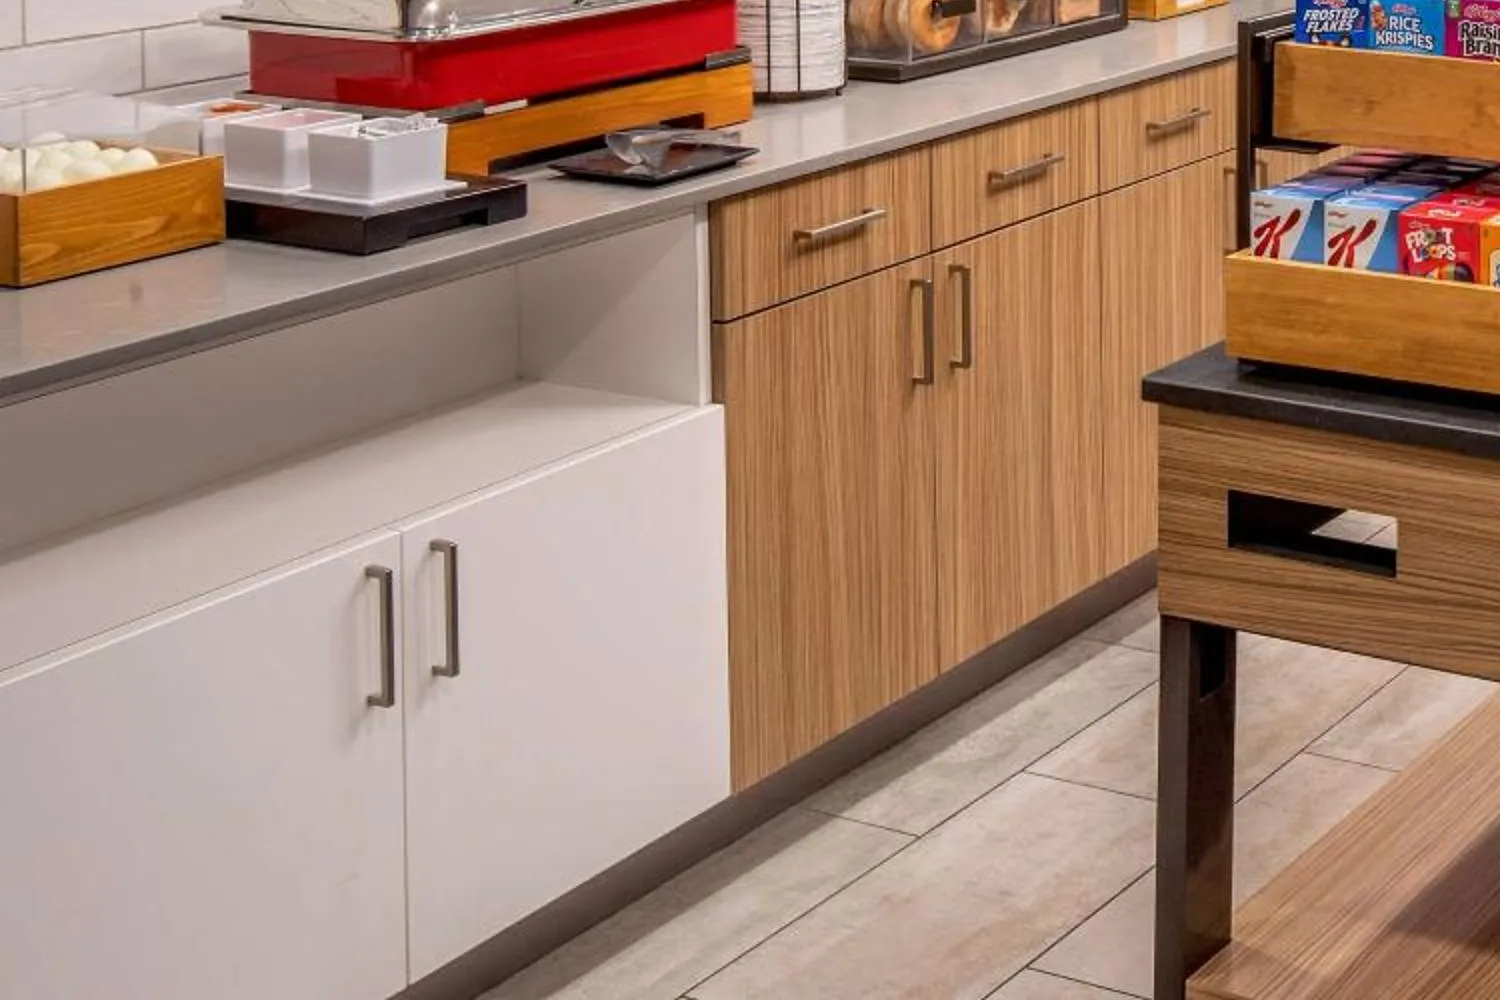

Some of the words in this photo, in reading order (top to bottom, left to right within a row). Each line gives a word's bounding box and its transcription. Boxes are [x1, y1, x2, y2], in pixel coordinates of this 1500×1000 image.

[1303, 7, 1360, 22] FROSTED
[1306, 19, 1354, 34] FLAKES
[1389, 15, 1422, 33] RICE
[1375, 31, 1434, 50] KRISPIES
[1254, 208, 1301, 260] K
[1328, 219, 1377, 269] K
